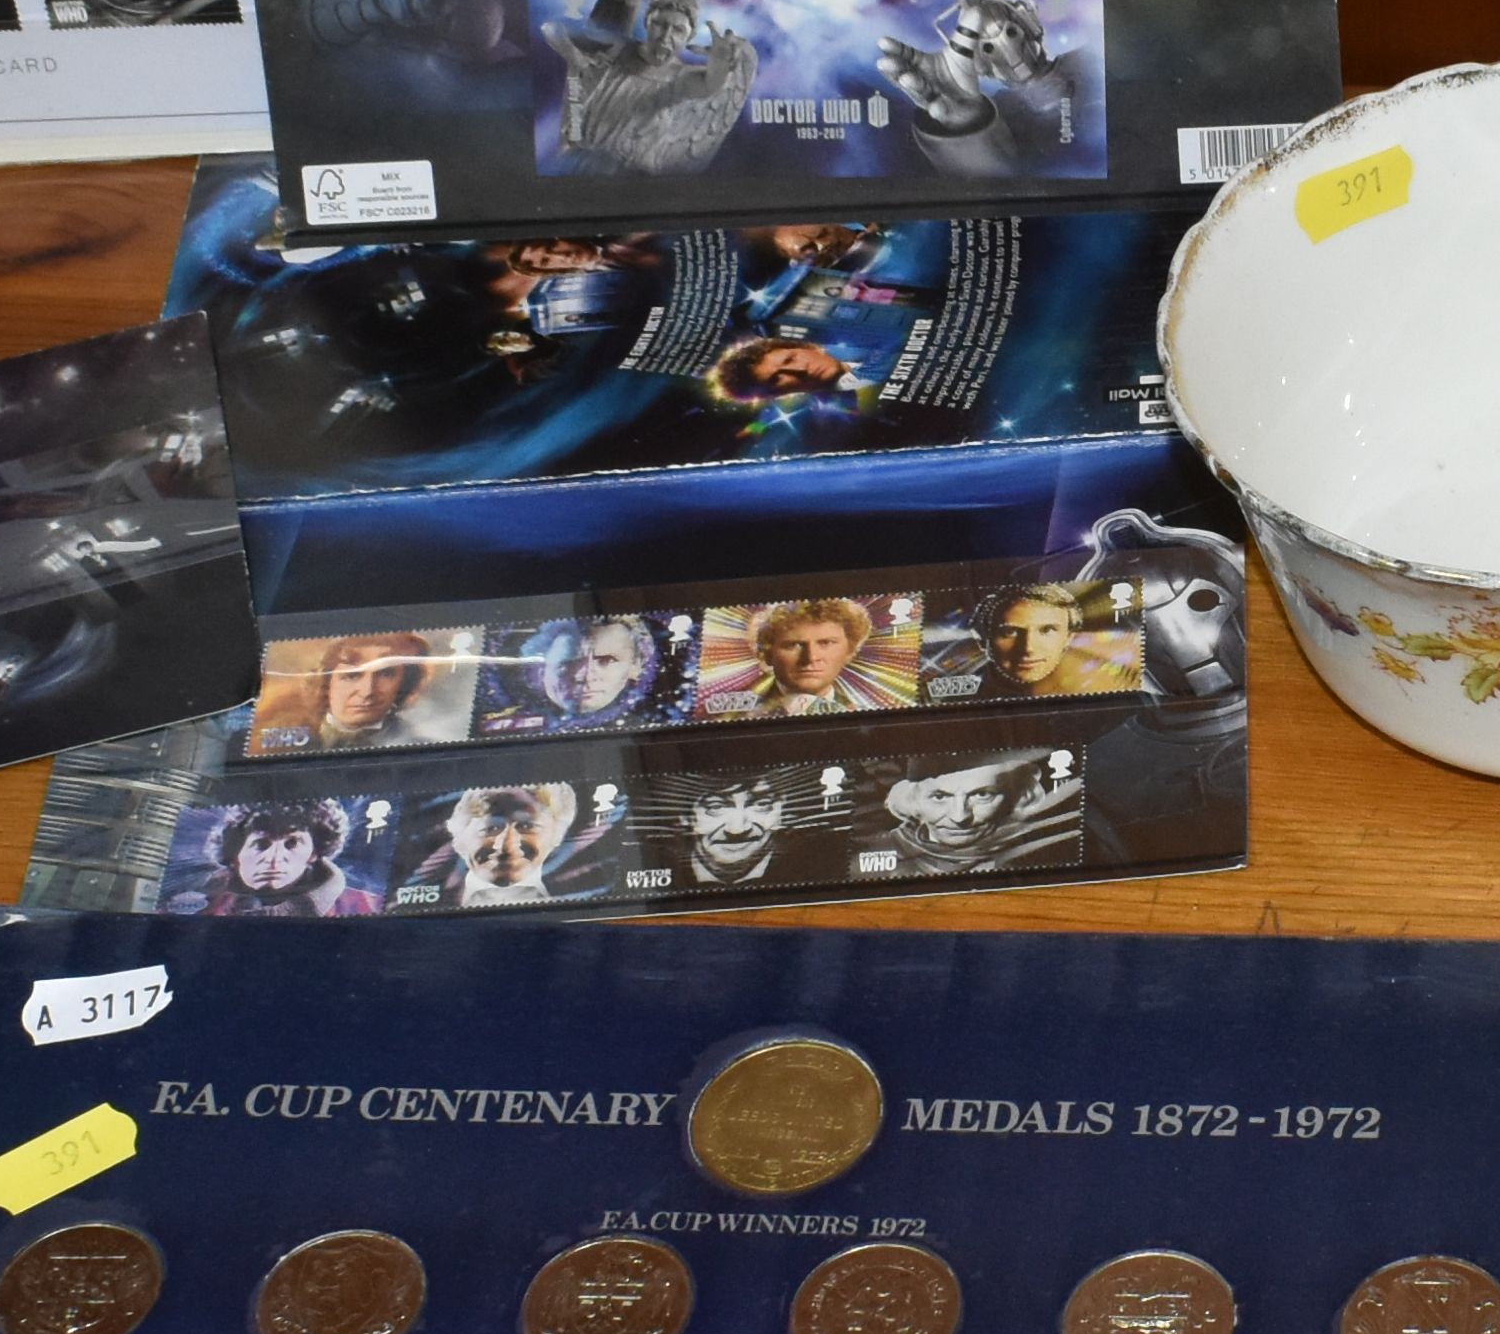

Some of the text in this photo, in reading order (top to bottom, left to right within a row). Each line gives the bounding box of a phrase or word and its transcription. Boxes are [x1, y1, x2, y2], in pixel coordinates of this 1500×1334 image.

[751, 97, 862, 124] DOCTOR WHO
[1337, 166, 1383, 206] 391
[319, 202, 347, 213] FSC
[879, 318, 934, 401] THE SIXTH DOCTOR
[859, 857, 897, 873] WHO
[626, 875, 672, 888] WHO
[397, 892, 440, 904] WHO
[36, 986, 162, 1031] A 3117
[150, 1081, 676, 1125] F.A. CUP CENTENARY
[902, 1099, 1114, 1134] MEDALS
[43, 1130, 102, 1176] 391
[719, 1213, 858, 1235] WINNERS
[869, 1217, 927, 1237] 1972
